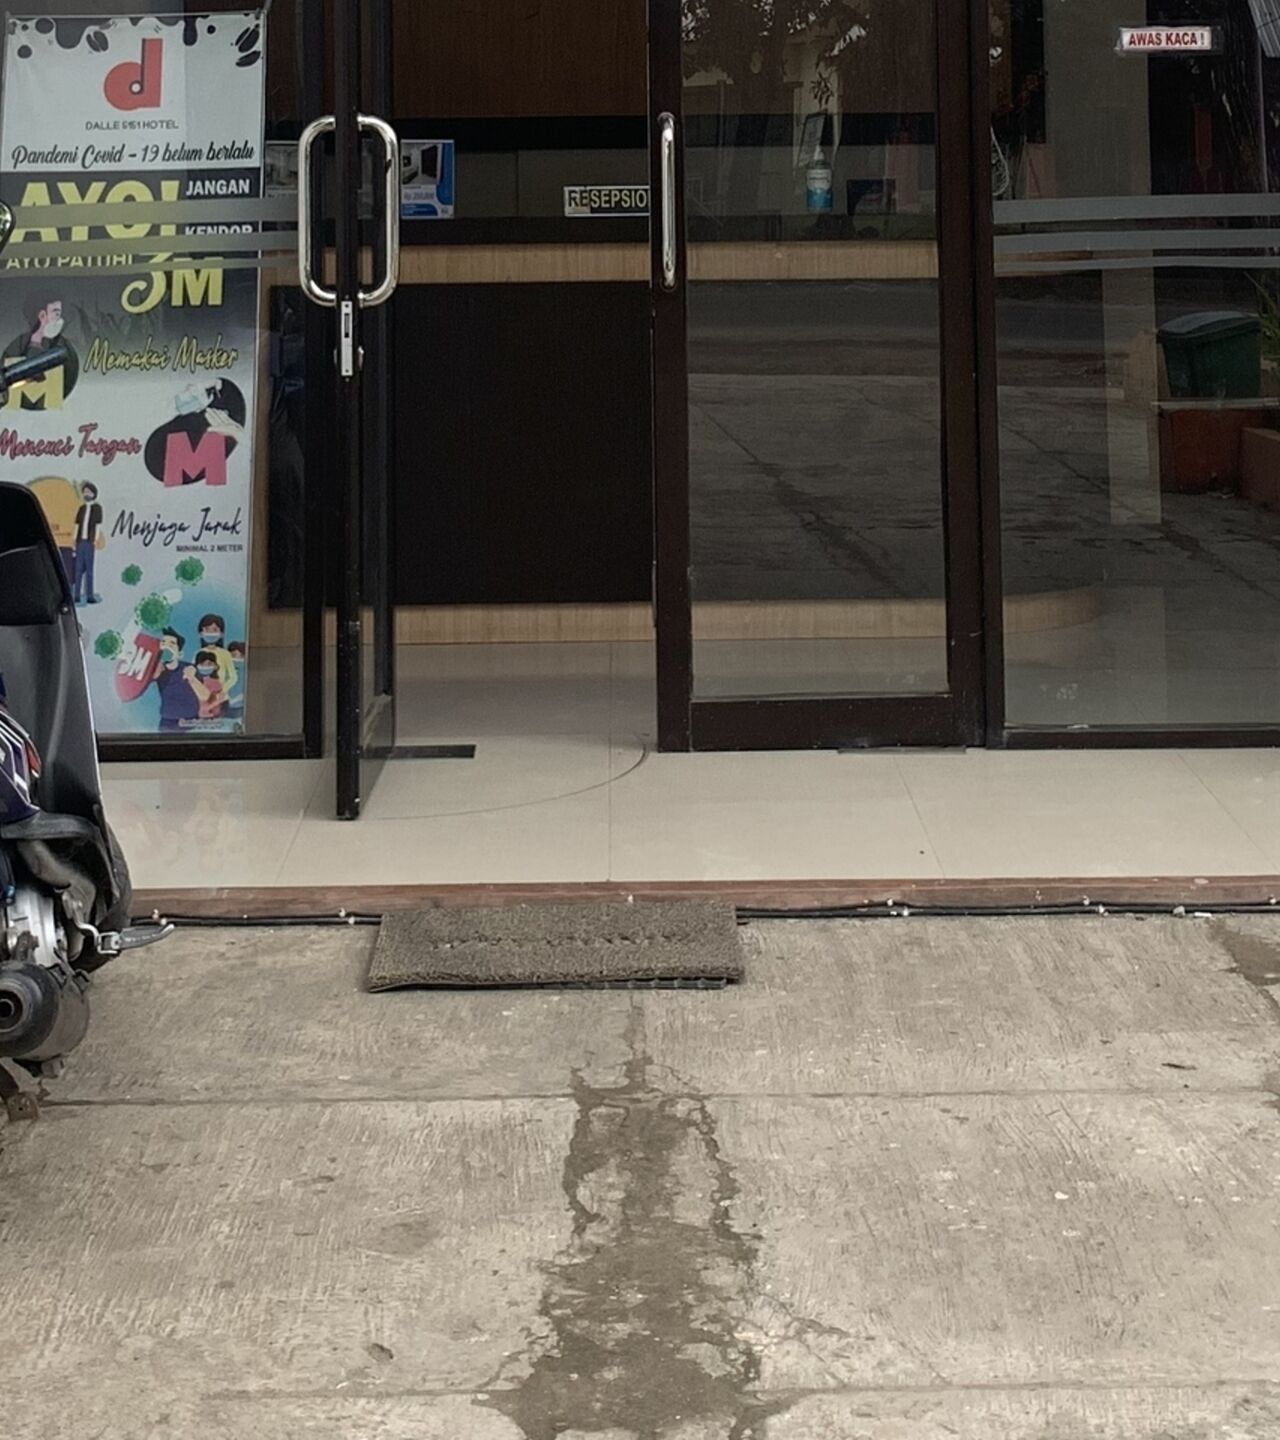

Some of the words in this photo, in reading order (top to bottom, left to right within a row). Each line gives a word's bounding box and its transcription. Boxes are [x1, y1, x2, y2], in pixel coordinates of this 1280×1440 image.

[1129, 33, 1162, 46] AWAS
[1166, 32, 1197, 46] KACA
[85, 121, 120, 130] DALLE
[143, 120, 179, 129] HOTEL
[12, 144, 79, 169] Pandemi
[81, 143, 125, 169] Covid
[141, 145, 160, 163] 19
[162, 143, 204, 163] belum
[206, 140, 255, 162] berlalu
[186, 179, 250, 196] JANGAN
[568, 190, 650, 208] RESEPSIO
[9, 180, 180, 243] AYO!
[84, 335, 170, 374] Memakai
[173, 335, 238, 373] Masker
[79, 423, 142, 465] Tangan
[164, 432, 228, 488] M
[111, 509, 191, 547] Menjaga
[193, 506, 242, 542] Jarak
[217, 544, 243, 552] METER
